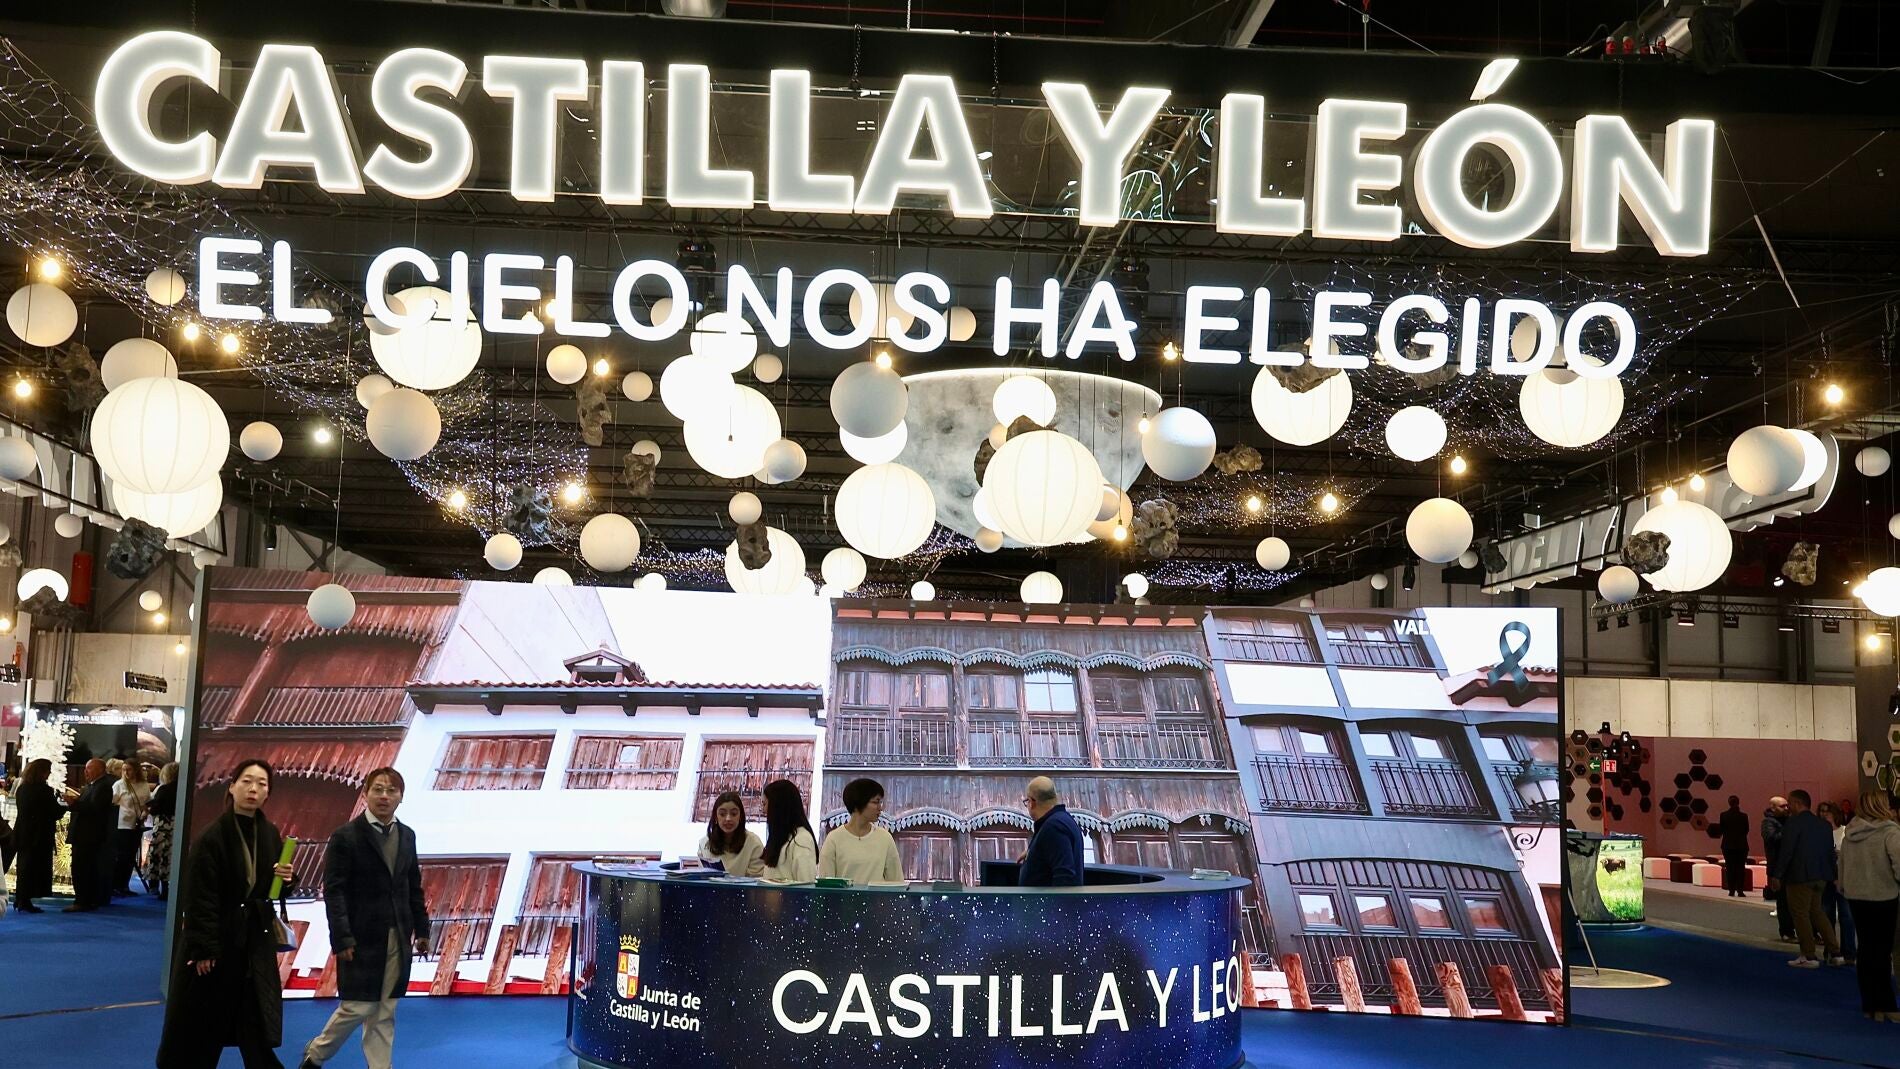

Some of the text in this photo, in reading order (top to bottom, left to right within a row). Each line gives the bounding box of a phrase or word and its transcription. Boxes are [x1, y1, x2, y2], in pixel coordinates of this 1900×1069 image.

[93, 30, 1716, 257] CASTILLA Y LEÓN
[198, 237, 1637, 379] EL CIELO NOS HA ELEGIDO
[1393, 619, 1429, 635] VAL
[610, 999, 700, 1032] Castilla y León
[640, 985, 701, 1010] Junta de
[772, 939, 1240, 1038] CASTILLA Y LEÓ
